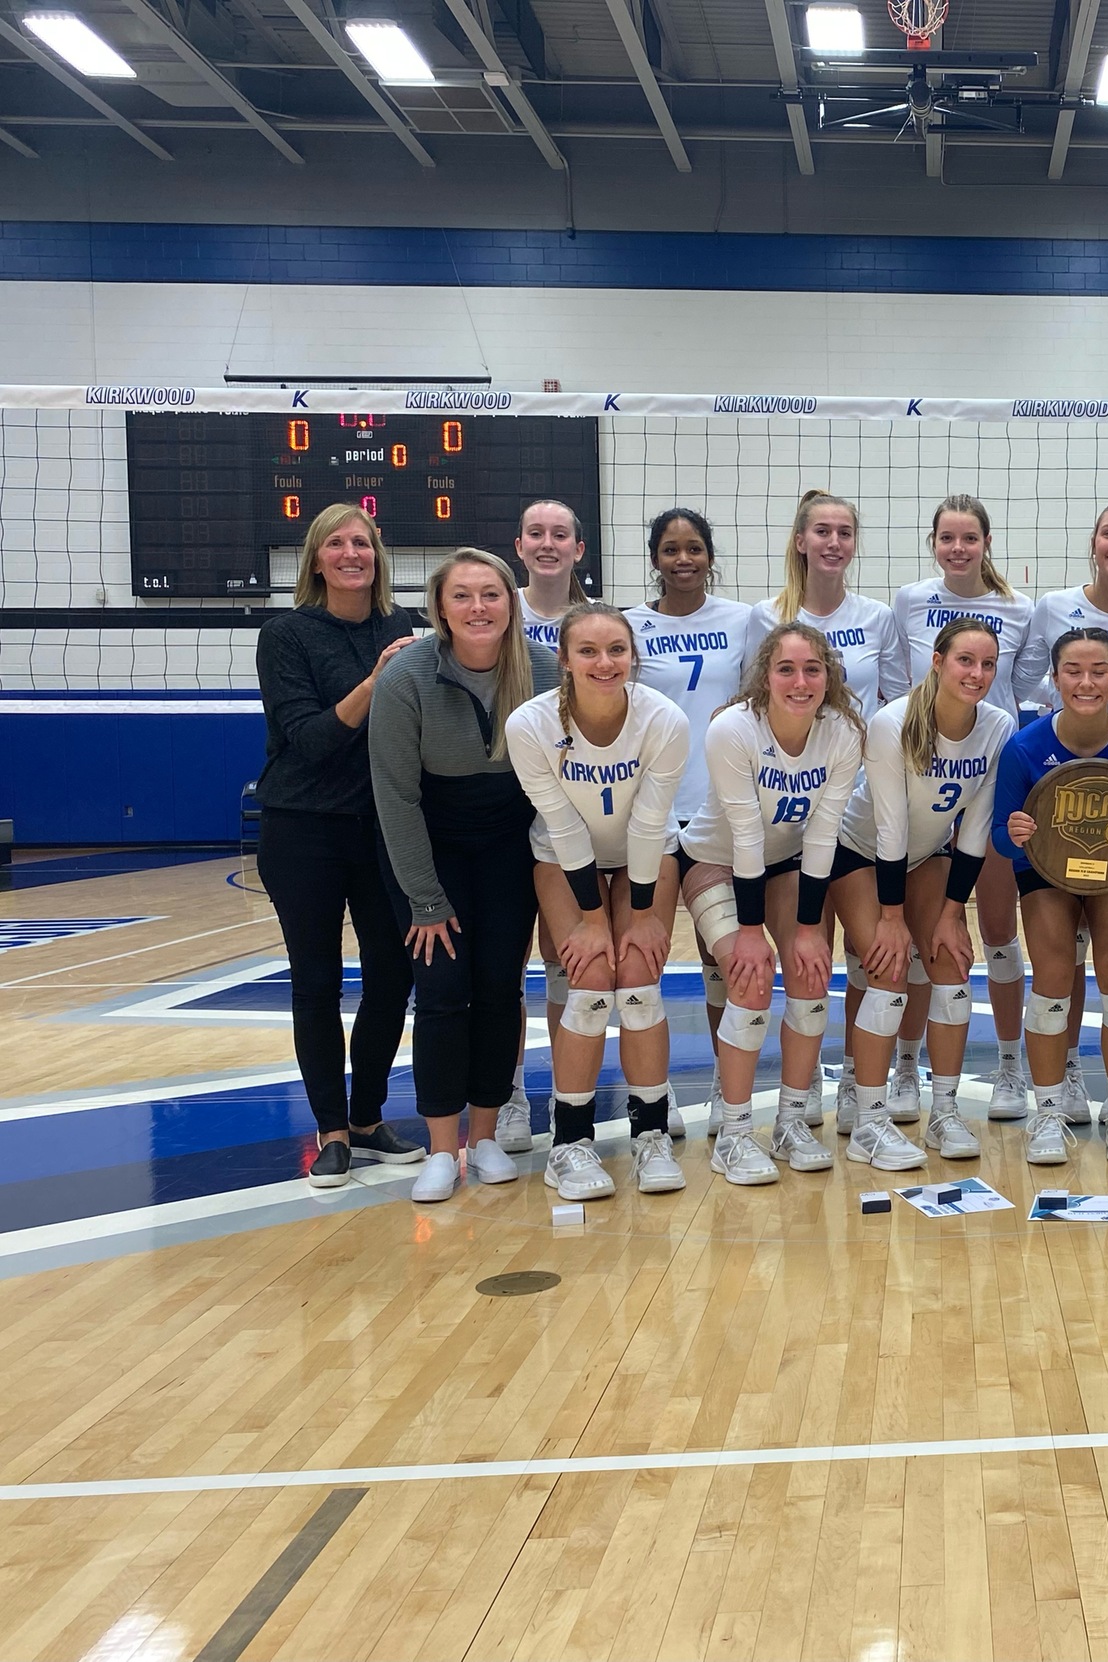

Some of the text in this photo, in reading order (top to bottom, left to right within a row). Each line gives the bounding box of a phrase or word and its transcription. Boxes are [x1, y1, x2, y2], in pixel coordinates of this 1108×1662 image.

[86, 387, 196, 405] KIRKWOOD
[292, 390, 309, 408] K
[406, 391, 511, 409] KIRKWOOD
[604, 394, 621, 411] K
[714, 396, 817, 414] KIRKWOOD
[907, 399, 923, 416] K
[289, 420, 310, 451] 0
[443, 421, 462, 452] 0
[345, 448, 384, 463] period
[392, 444, 407, 467] 0
[274, 475, 302, 489] fouls
[345, 474, 384, 489] player
[427, 475, 455, 489] fouls
[436, 496, 451, 519] 0
[646, 631, 728, 657] KIRKWOOD
[679, 654, 703, 691] 7
[758, 765, 827, 794] KIRKWOOD
[601, 787, 614, 815] 1
[931, 782, 963, 812] 3
[771, 796, 811, 825] 18
[1068, 825, 1102, 835] REGION
